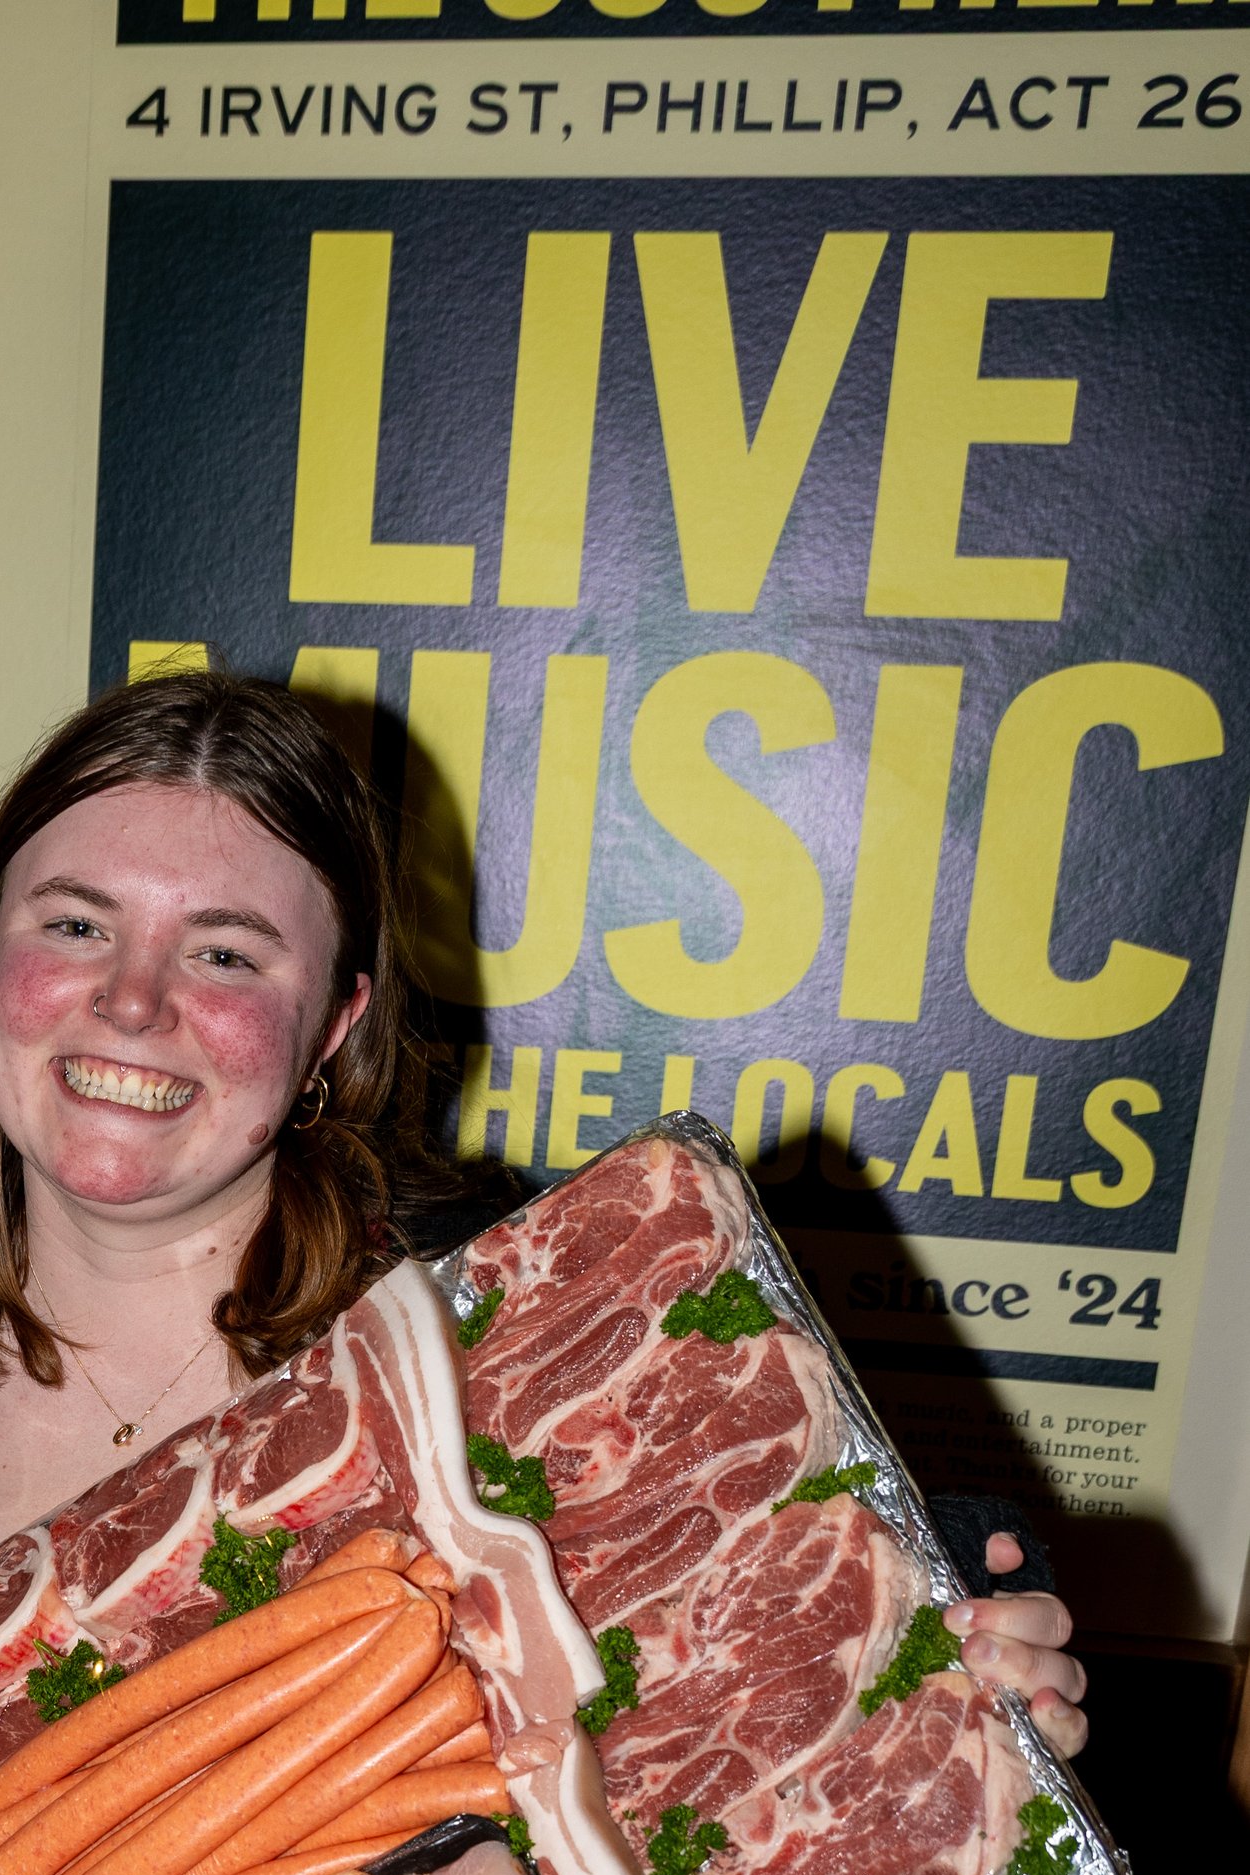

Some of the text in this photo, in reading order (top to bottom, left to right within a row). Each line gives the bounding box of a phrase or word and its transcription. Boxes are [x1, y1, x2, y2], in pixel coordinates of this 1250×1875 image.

[125, 86, 171, 138] 4
[200, 83, 438, 138] IRVING
[466, 81, 574, 142] ST,
[601, 78, 919, 141] PHILLIP,
[947, 75, 1111, 132] ACT
[288, 230, 1115, 622] LIVE
[846, 1259, 1030, 1319] since
[985, 1408, 1029, 1428] and
[1040, 1415, 1055, 1429] a
[1065, 1415, 1147, 1437] proper
[953, 1431, 1141, 1463] entertainment.
[1043, 1465, 1078, 1485] for
[1081, 1471, 1139, 1491] your
